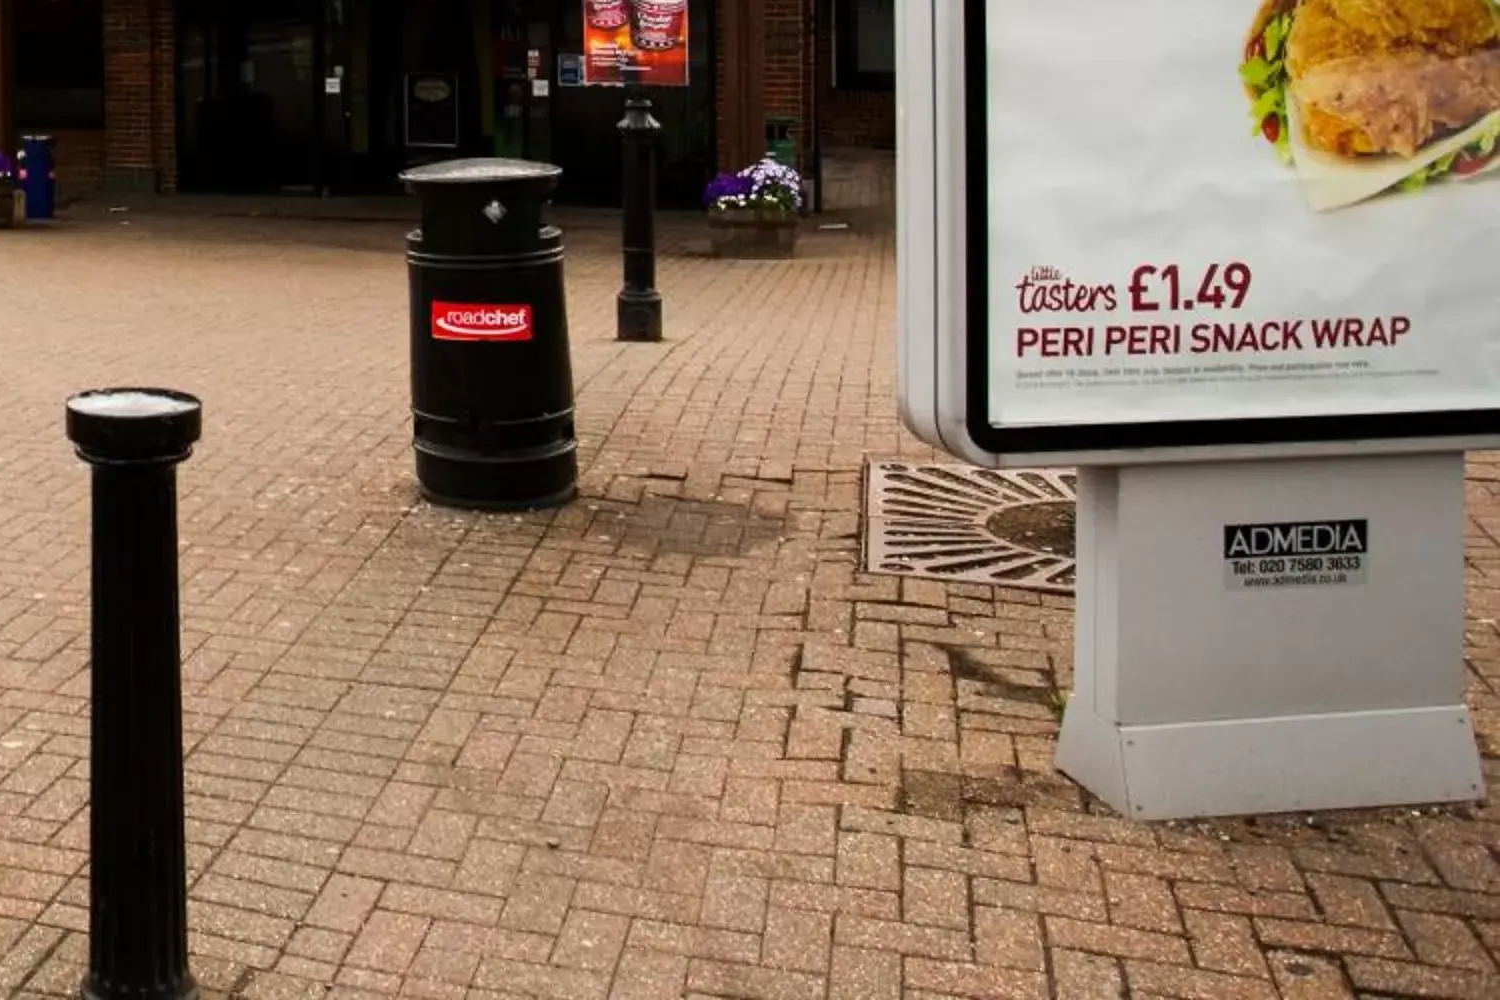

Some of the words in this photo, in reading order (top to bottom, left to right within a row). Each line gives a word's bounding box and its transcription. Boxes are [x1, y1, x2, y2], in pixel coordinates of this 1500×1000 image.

[1015, 274, 1118, 314] tasters
[1128, 262, 1253, 311] £1.49
[447, 308, 527, 326] roadchef
[1016, 326, 1094, 358] PERI
[1104, 324, 1181, 355] PERI
[1190, 320, 1304, 354] SNACK
[1310, 316, 1411, 349] WRAP
[1228, 523, 1364, 556] ADMEDIA
[1232, 560, 1255, 575] Tel:
[1259, 559, 1285, 574] 020
[1289, 557, 1324, 573] 7580
